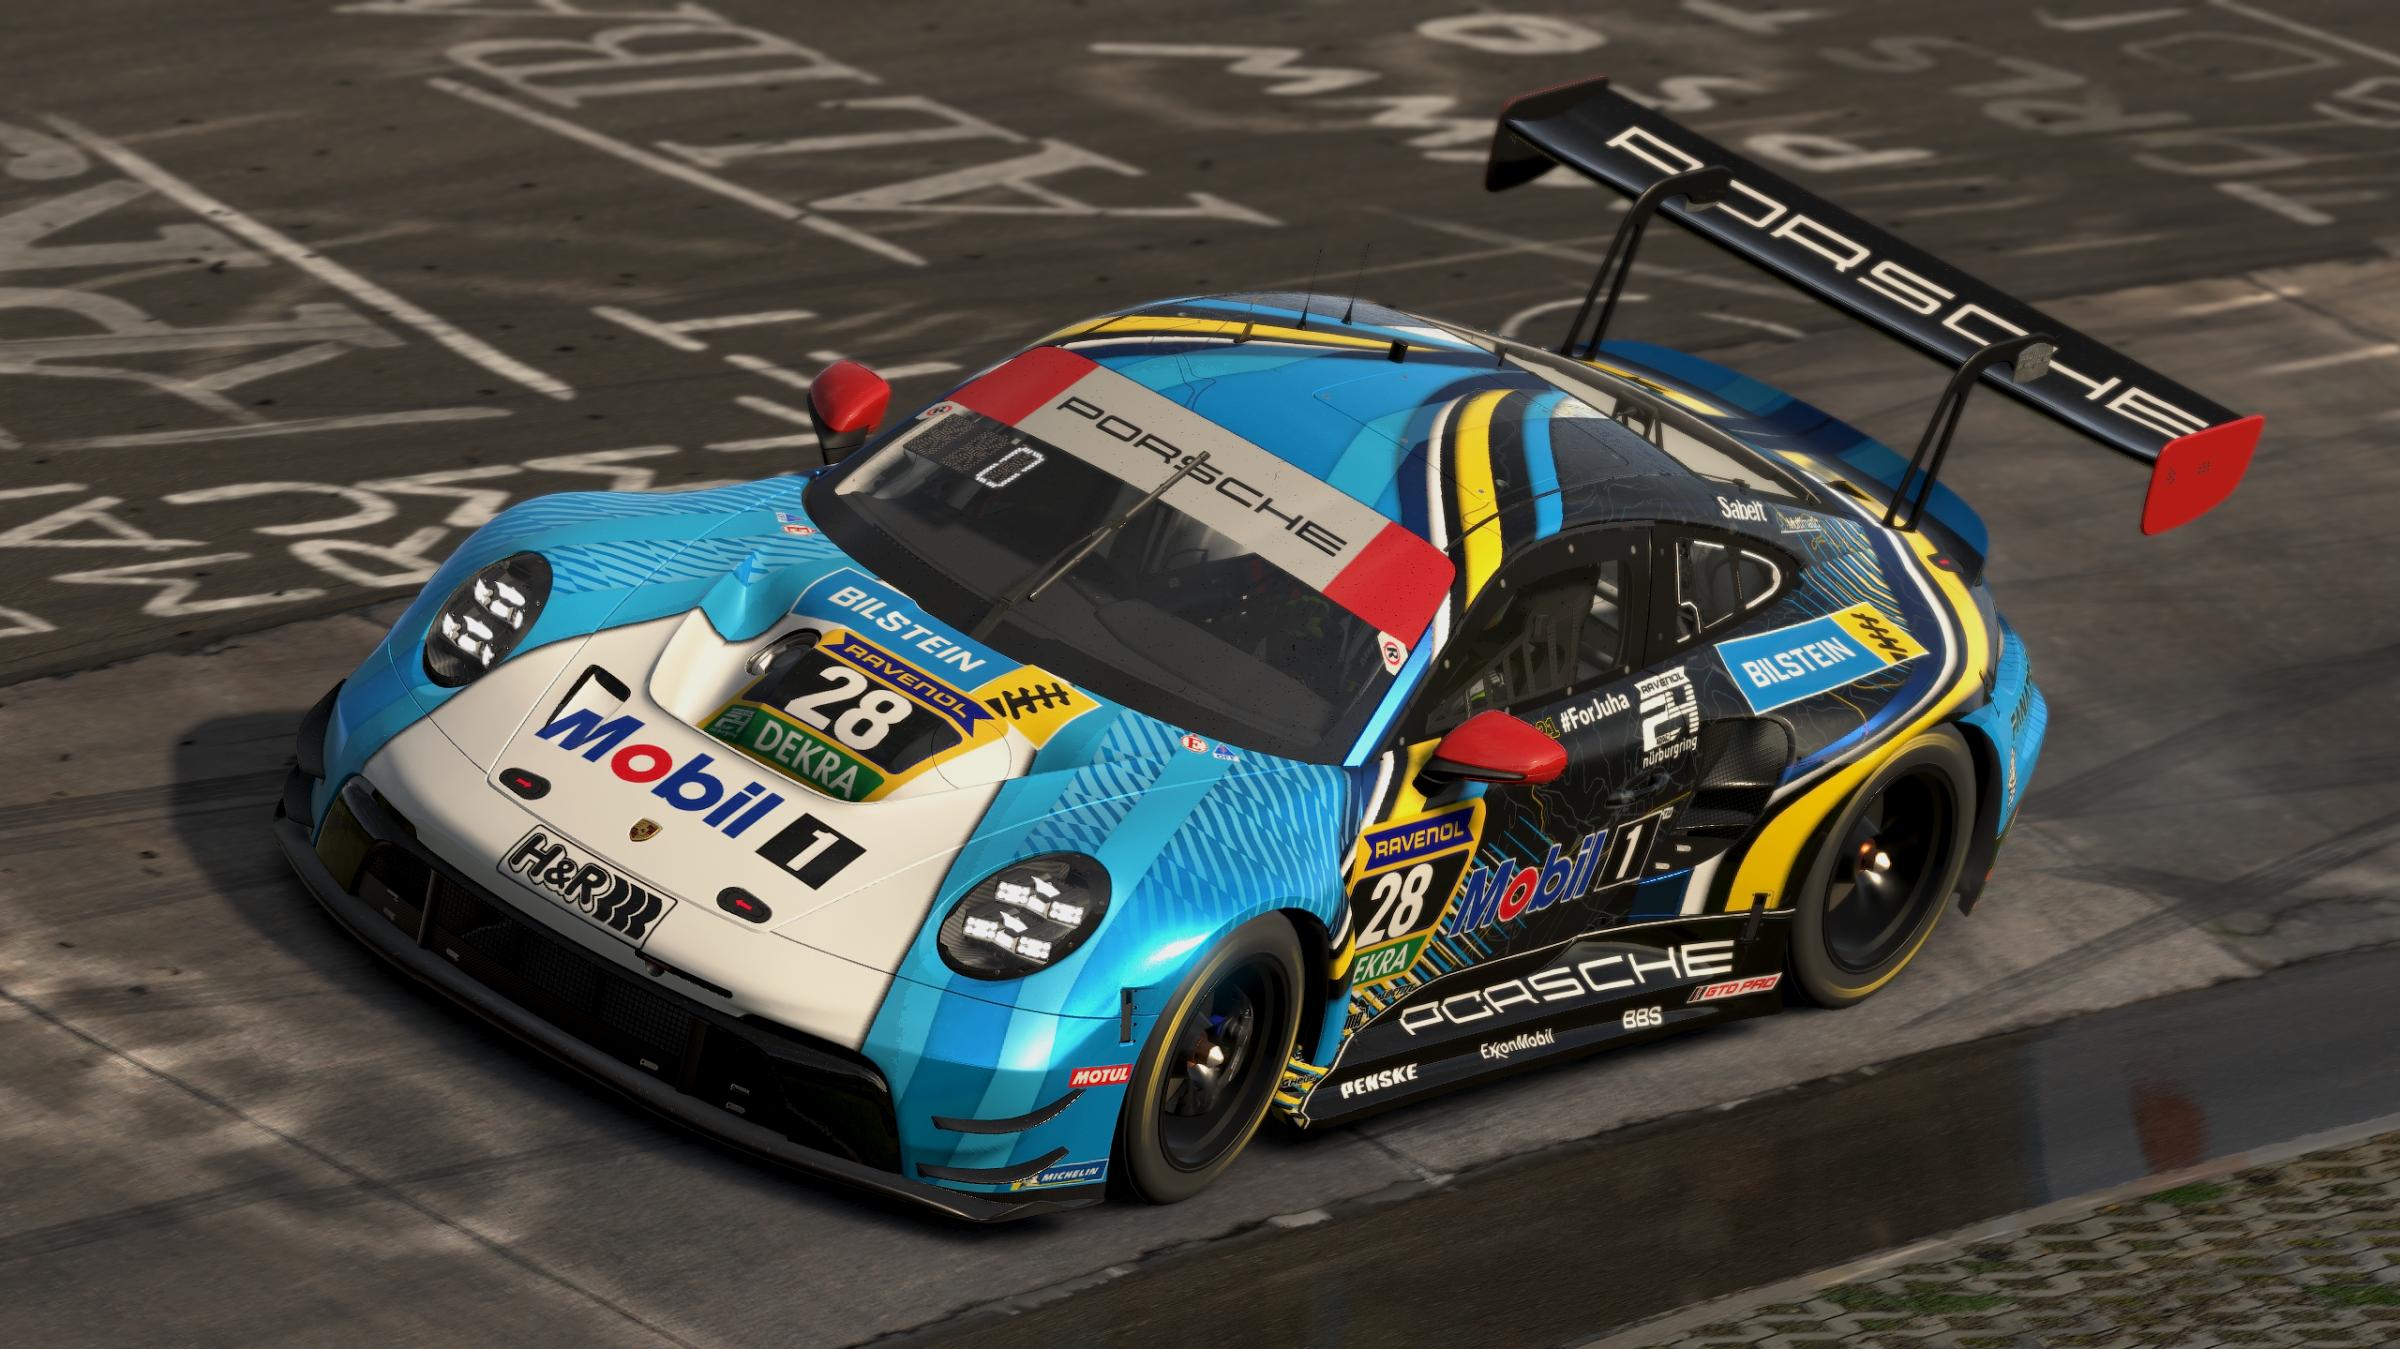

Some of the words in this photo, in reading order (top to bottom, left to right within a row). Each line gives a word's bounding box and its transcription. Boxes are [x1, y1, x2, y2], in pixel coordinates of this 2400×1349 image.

[1057, 396, 1347, 557] PORSCHE
[1717, 496, 1768, 522] Sabelt
[828, 585, 986, 673] BILSTEIN
[843, 643, 969, 718] RAVENOL
[1641, 672, 1684, 695] RAVENOL
[1743, 636, 1857, 688] BILSTEIN
[784, 665, 913, 750] 28
[1560, 692, 1631, 734] #ForJuha
[753, 719, 859, 799] DEKRA
[1643, 735, 1698, 769] nürburgring
[535, 708, 785, 840] Mobil
[784, 828, 834, 875] 1
[1375, 821, 1464, 859] RAVENOL
[509, 832, 612, 913] H&R
[1448, 829, 1609, 937] Mobil
[1615, 823, 1643, 881] 1
[1357, 863, 1434, 948] 28
[1352, 943, 1409, 983] EKRA
[1400, 940, 1735, 1035] PORSCHE
[1622, 1006, 1664, 1029] BBS
[1481, 1028, 1555, 1060] ExxonMobil
[1072, 1067, 1129, 1086] MOTUL
[1340, 1063, 1418, 1099] PENSKE
[1041, 1167, 1099, 1183] MICHELIN
